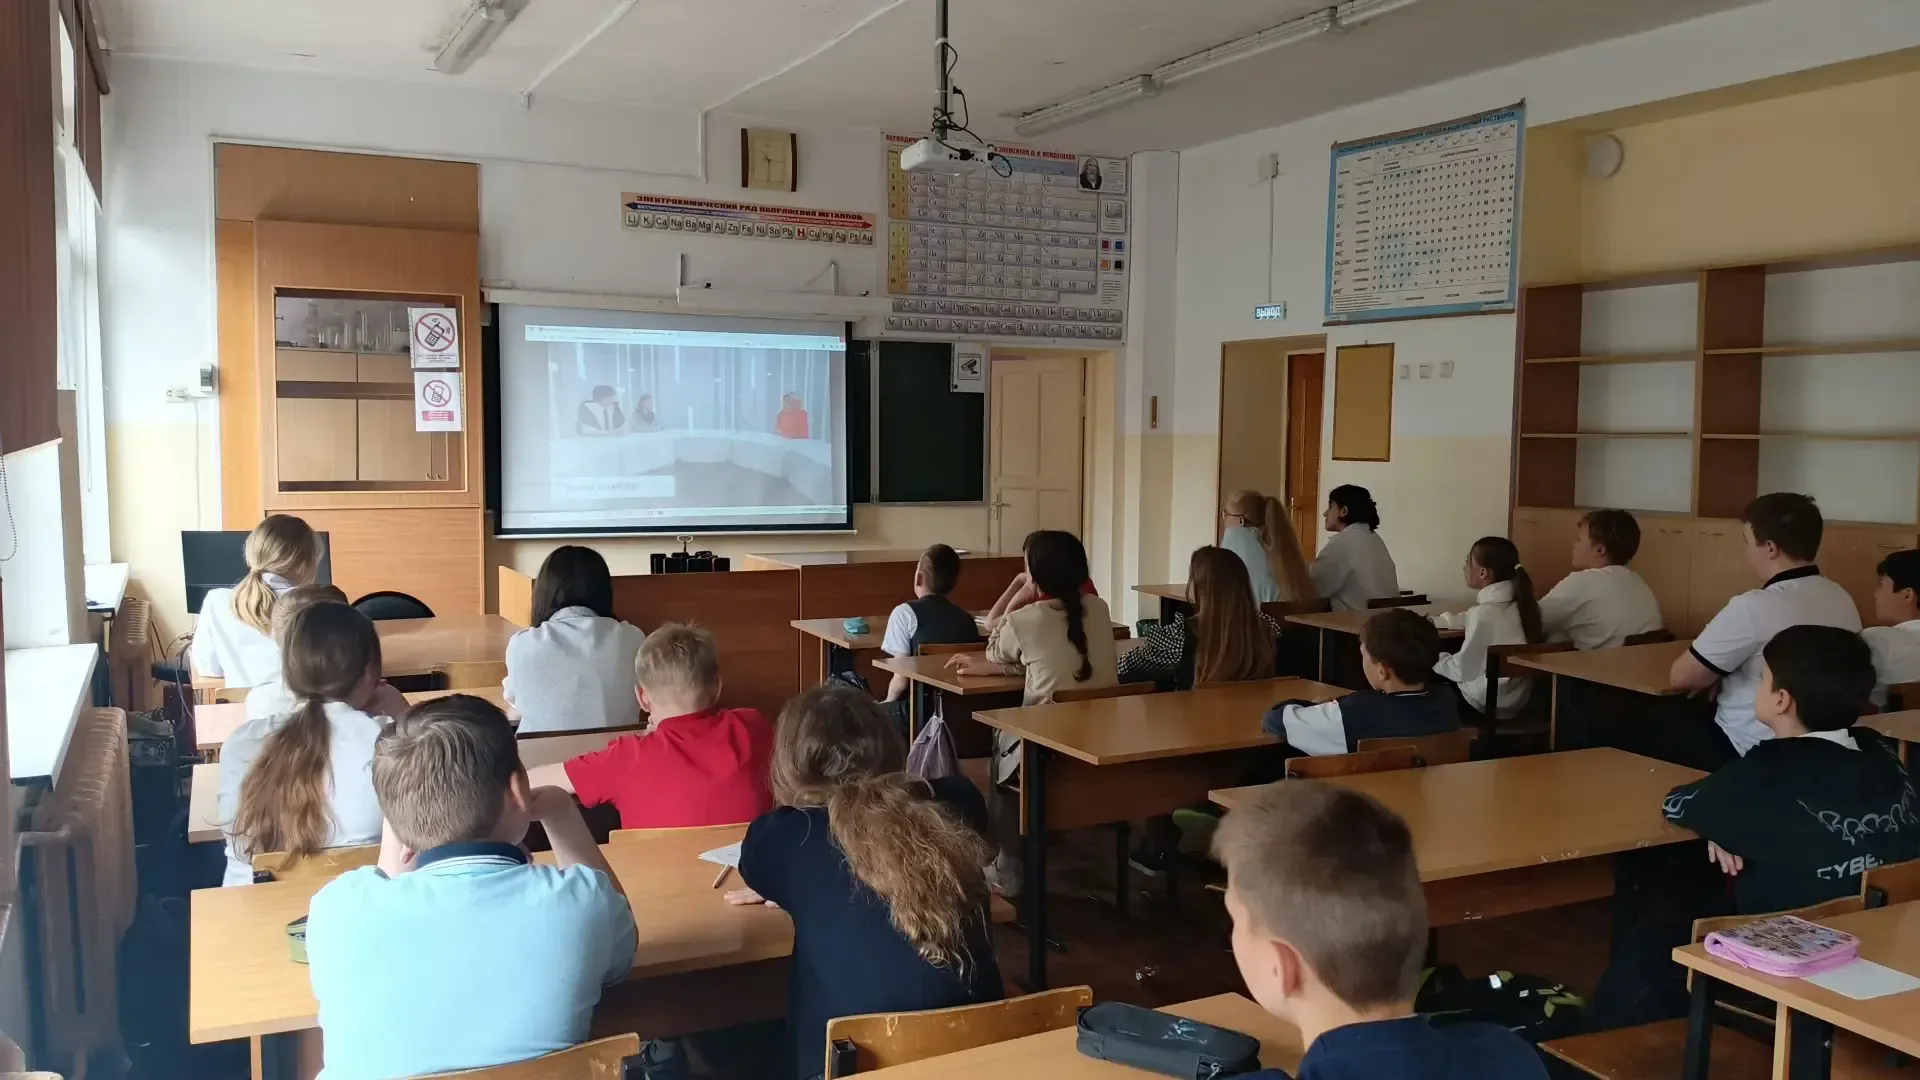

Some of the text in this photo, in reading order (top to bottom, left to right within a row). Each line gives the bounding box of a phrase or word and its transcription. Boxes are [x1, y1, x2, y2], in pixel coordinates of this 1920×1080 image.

[636, 195, 738, 210] ЭЛЕКТРОХИМИЧЕСКИЙ
[818, 212, 862, 220] МЕТАЛЛОВ
[699, 222, 711, 230] Mg
[797, 228, 805, 236] H
[823, 231, 833, 240] Hg
[836, 232, 846, 240] Ag
[1256, 307, 1280, 318] ВЫХОД
[1816, 853, 1883, 880] CYBE
